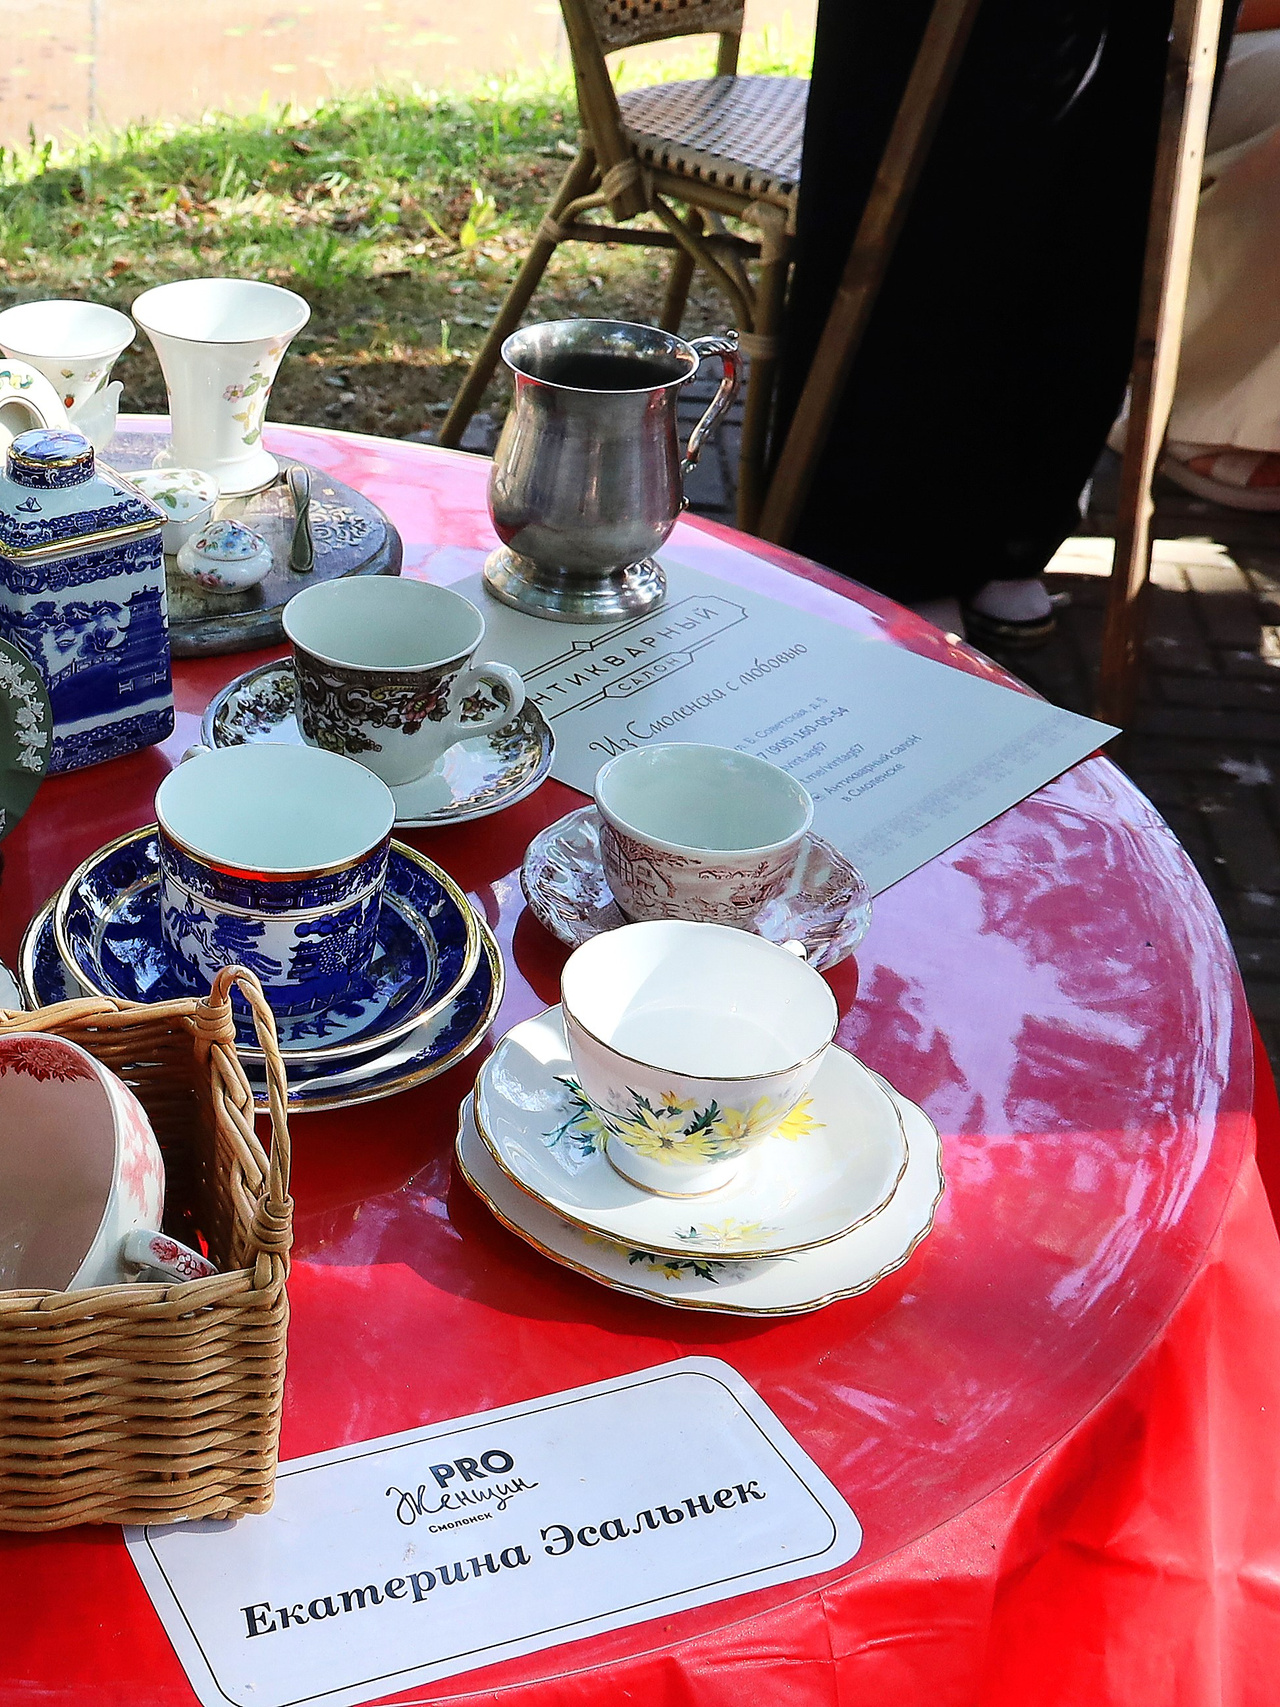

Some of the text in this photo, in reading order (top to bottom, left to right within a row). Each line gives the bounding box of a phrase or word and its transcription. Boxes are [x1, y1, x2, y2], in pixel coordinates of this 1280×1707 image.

[531, 607, 718, 706] НТИКВАРНЫЙ
[618, 657, 681, 691] САЛОН
[626, 691, 726, 740] Смоленска
[730, 643, 808, 686] любовью
[765, 736, 798, 756] (905)
[823, 753, 893, 795] Антикварный
[847, 763, 906, 797] Смоленске
[429, 1449, 515, 1489] PRO
[385, 1477, 539, 1526] Женщин
[240, 1475, 768, 1640] Екатерина Эсальнек
